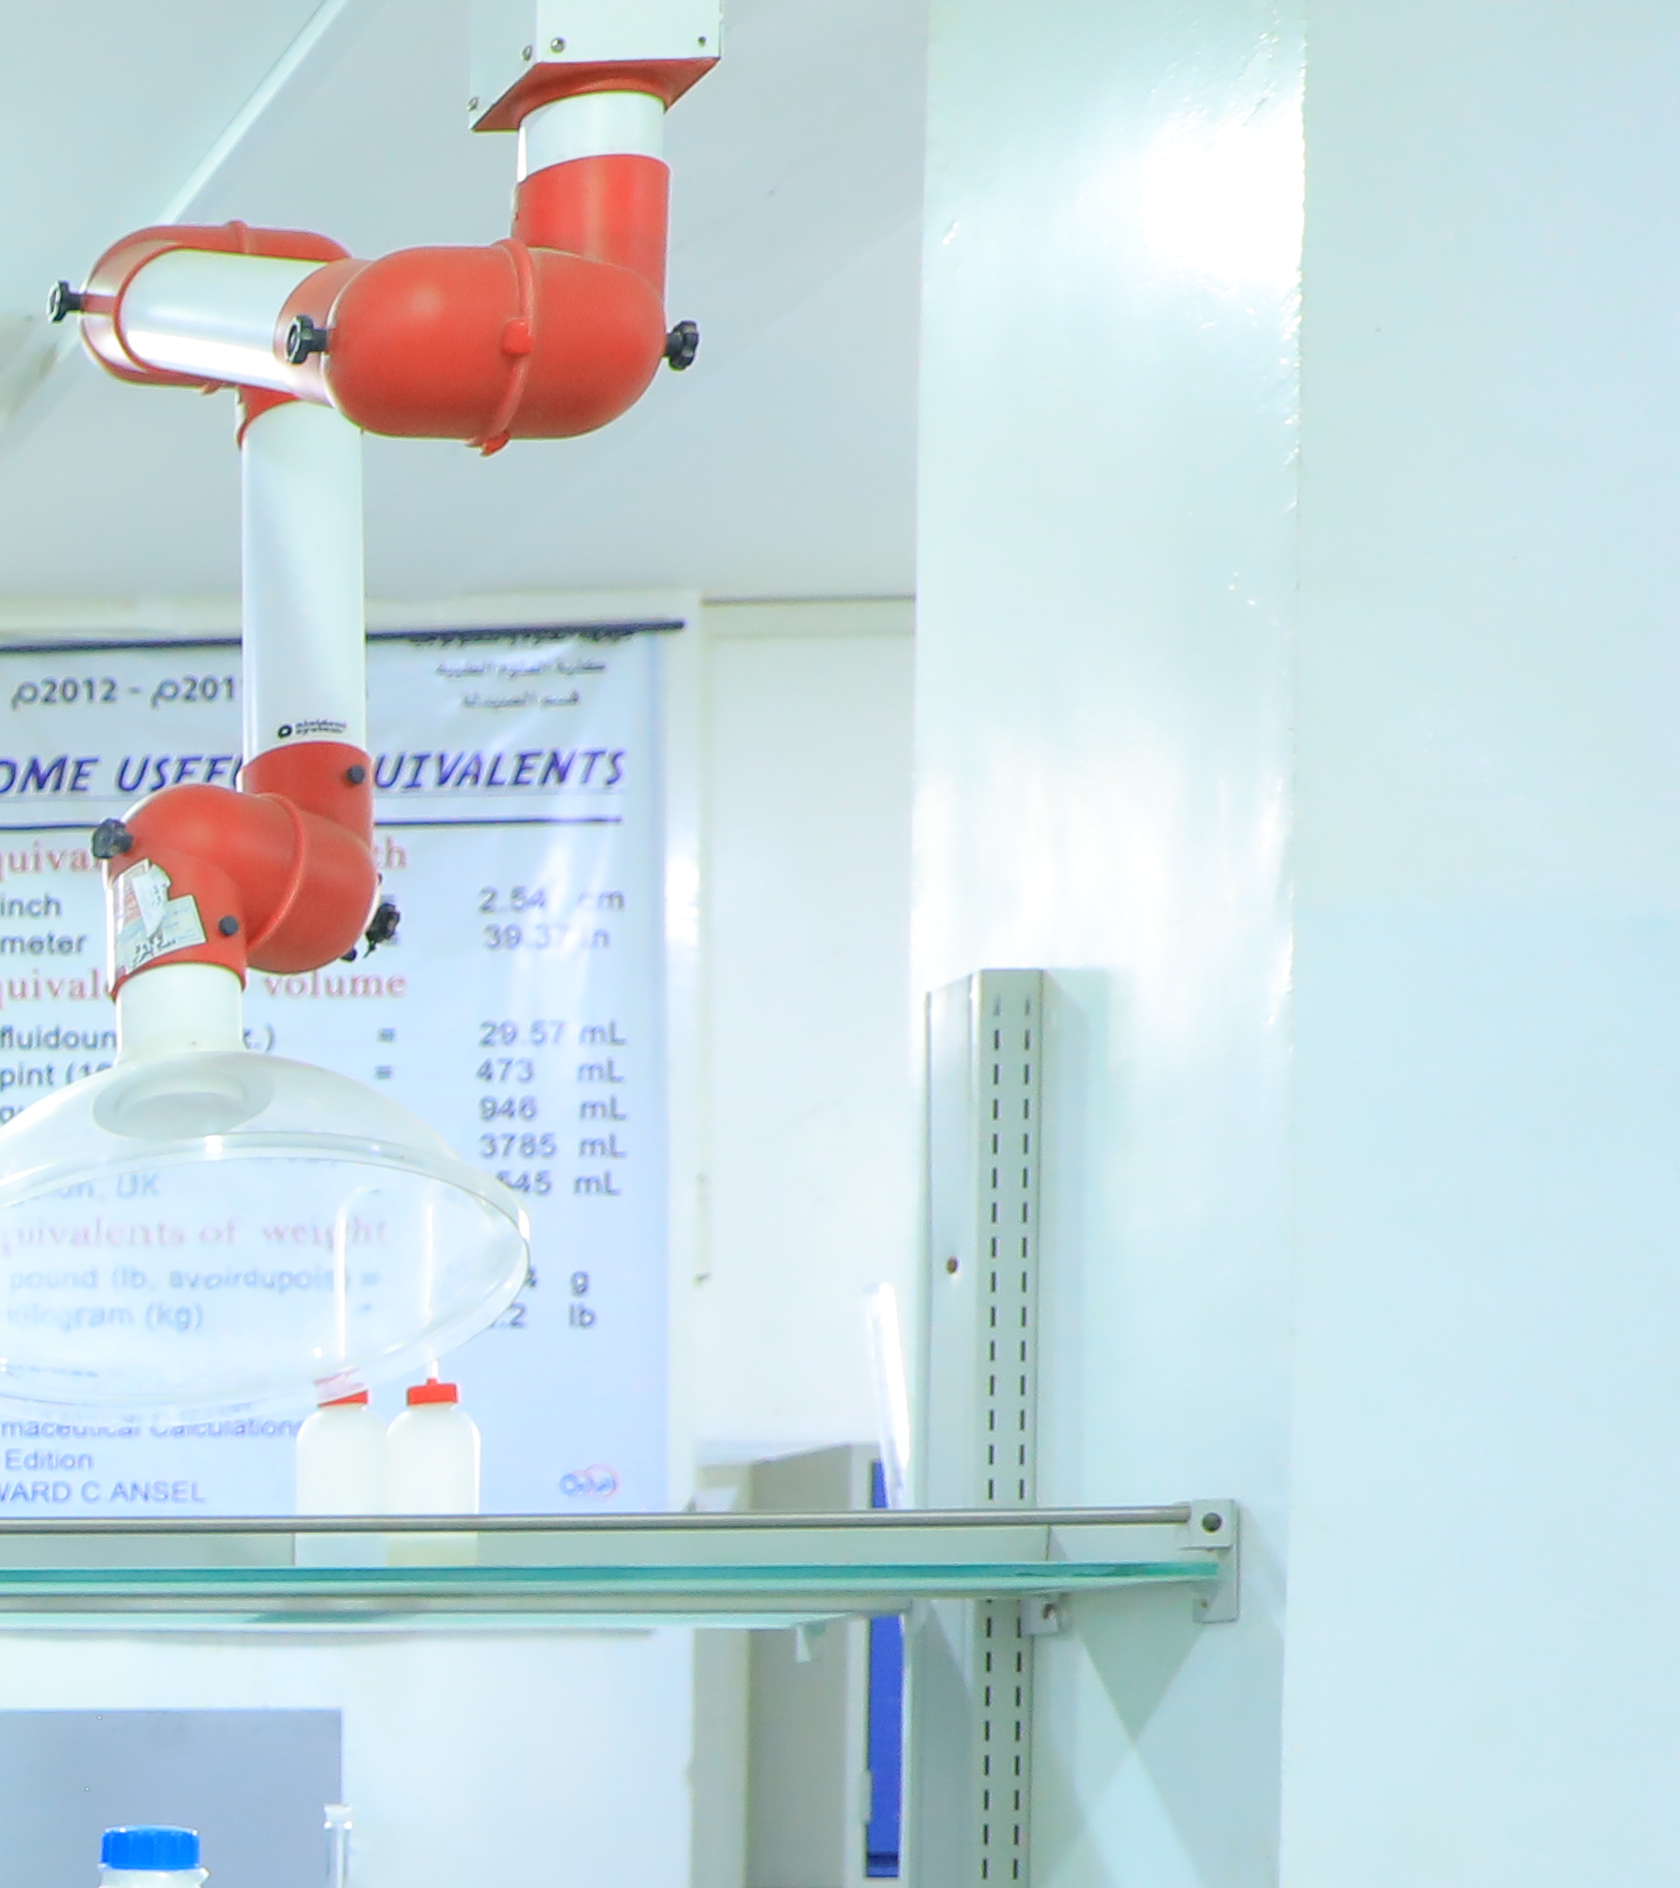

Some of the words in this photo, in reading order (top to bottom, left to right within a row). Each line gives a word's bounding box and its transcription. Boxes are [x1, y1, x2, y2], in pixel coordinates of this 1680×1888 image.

[374, 747, 626, 789] UIVALENTS
[0, 891, 63, 918] inch
[0, 931, 89, 957] meter
[264, 972, 407, 998] volume
[579, 1018, 627, 1046] mL
[476, 1056, 535, 1083] 473
[577, 1055, 626, 1083] mL
[579, 1094, 627, 1121] mL
[478, 1132, 558, 1159] 3785
[579, 1131, 627, 1158] mL
[573, 1169, 621, 1196] mL
[4, 1448, 93, 1471] Edition
[110, 1480, 207, 1504] ANSEL
